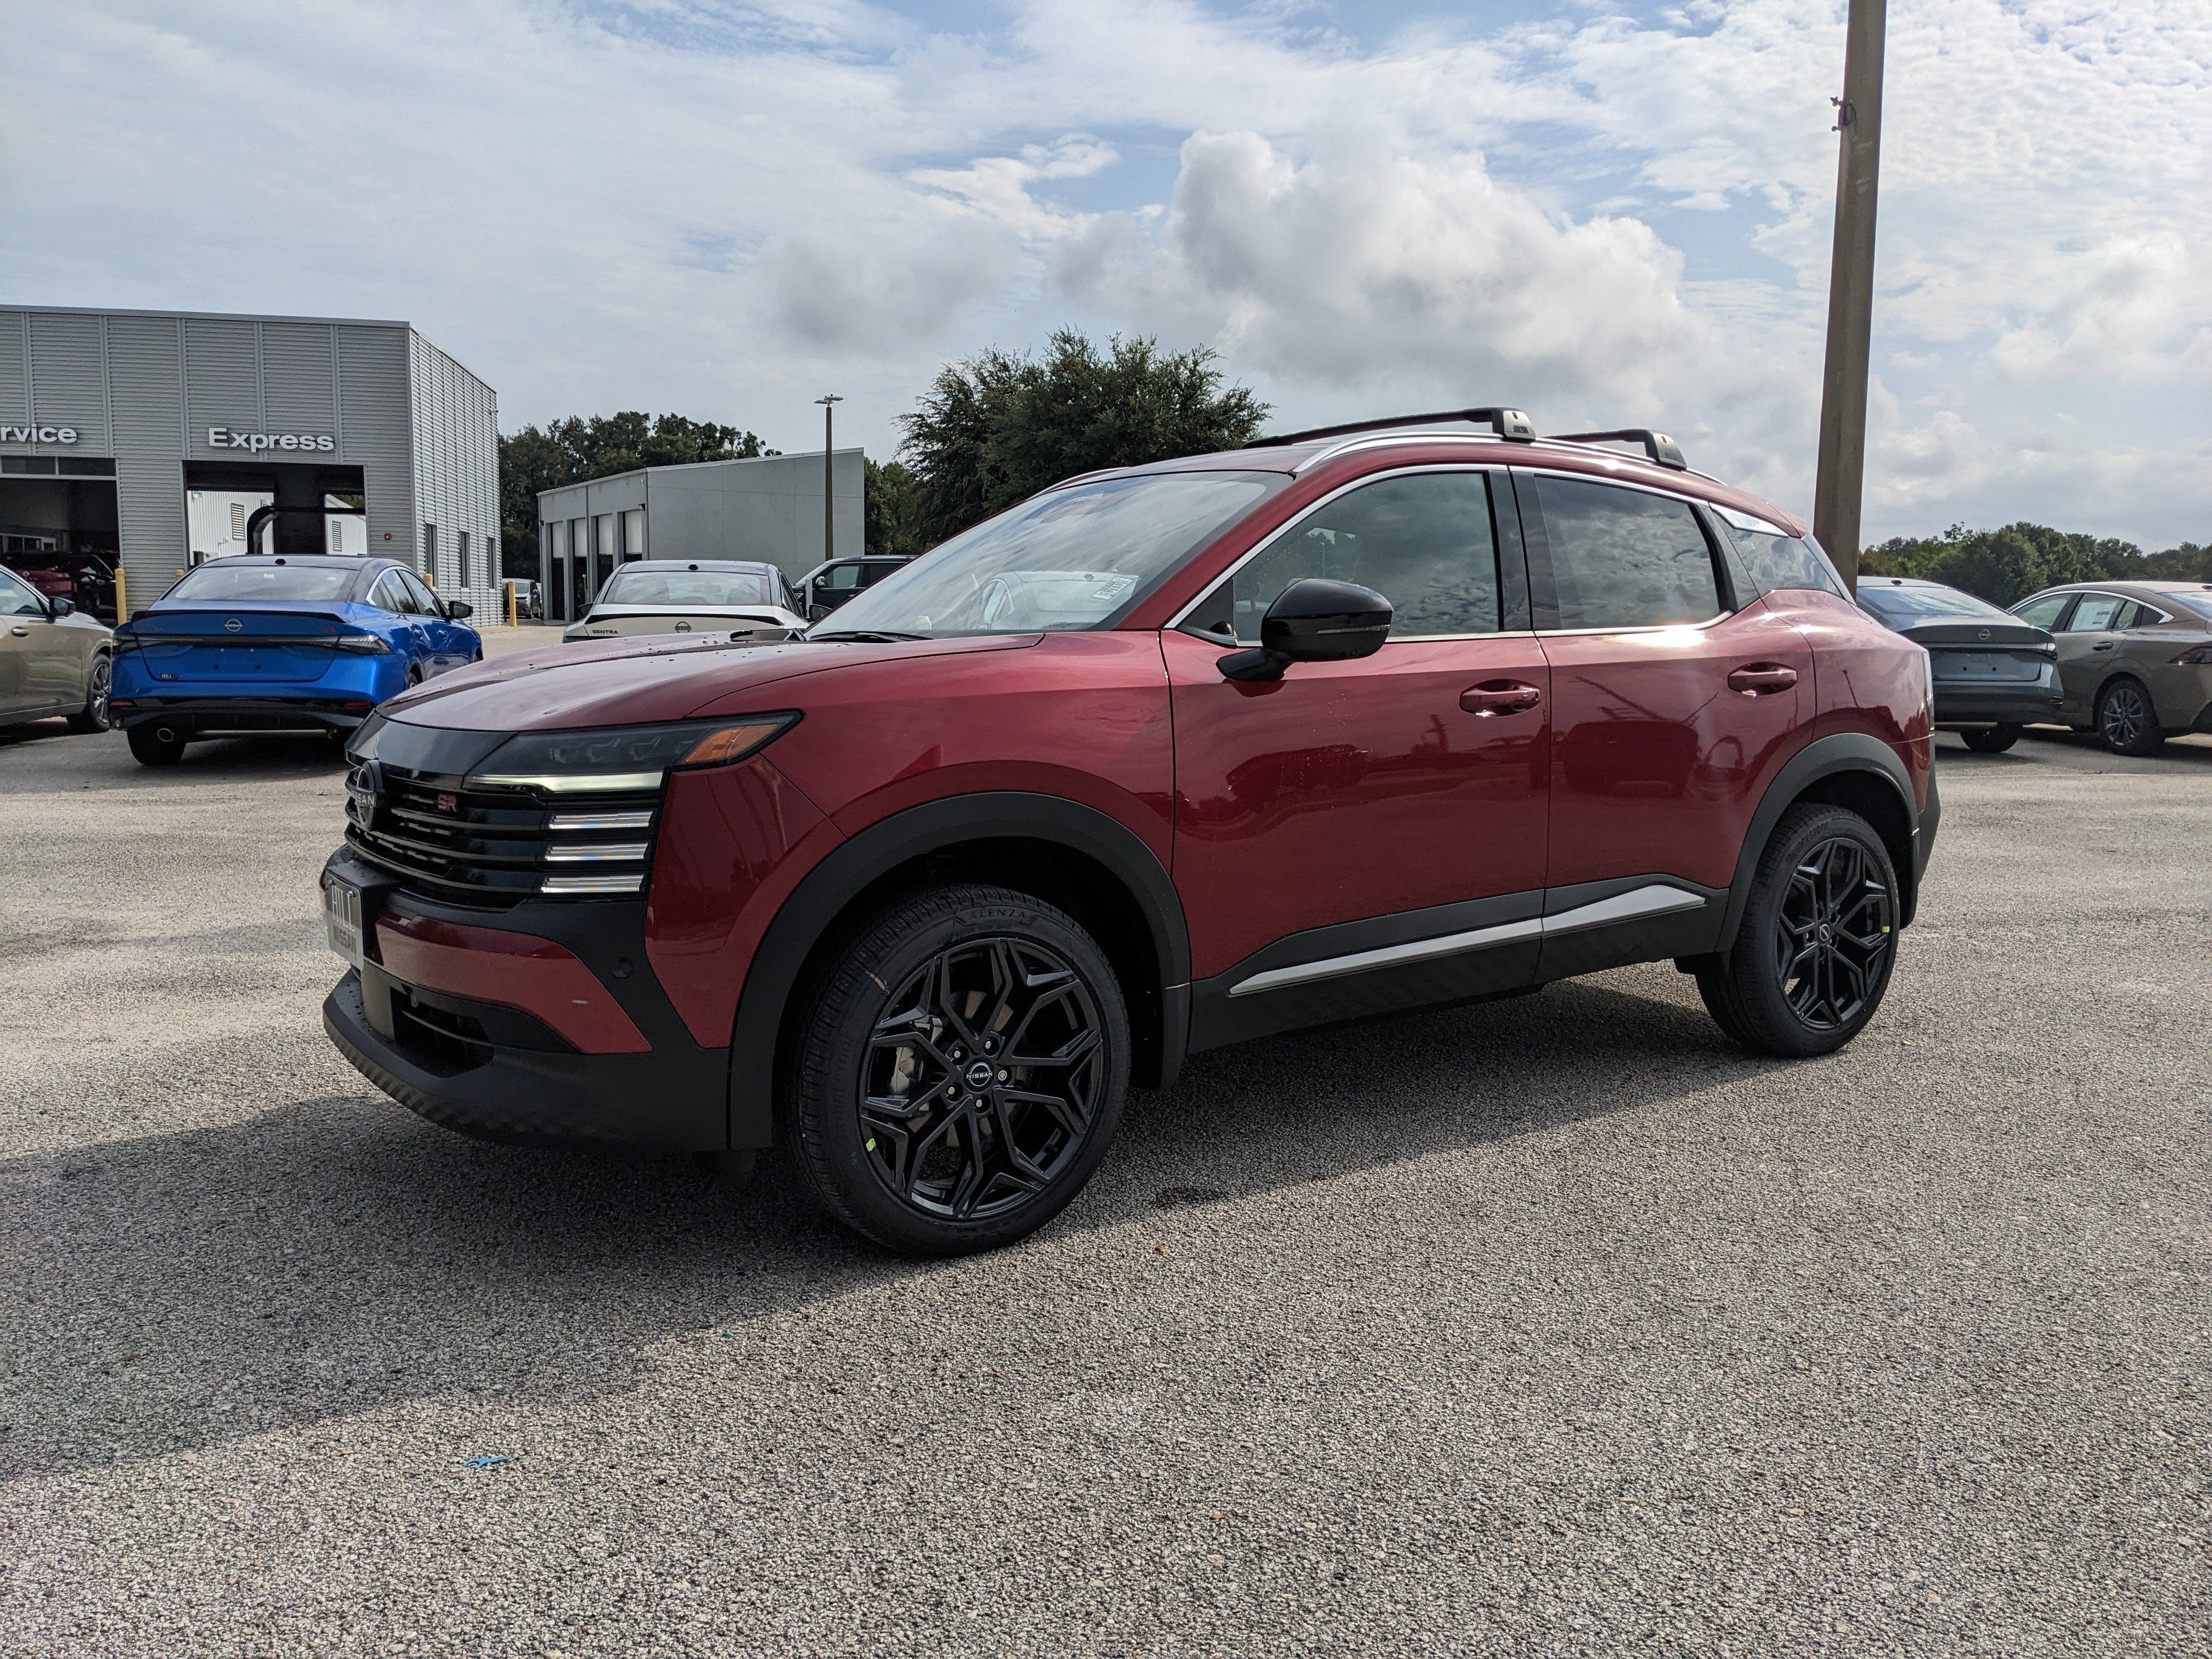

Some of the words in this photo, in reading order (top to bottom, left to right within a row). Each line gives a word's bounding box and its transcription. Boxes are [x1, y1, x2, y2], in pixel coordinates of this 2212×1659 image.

[1, 423, 77, 443] rvice
[208, 427, 334, 453] Express
[438, 794, 456, 812] SR
[332, 885, 355, 932] HILL
[969, 909, 1025, 919] ALENZA
